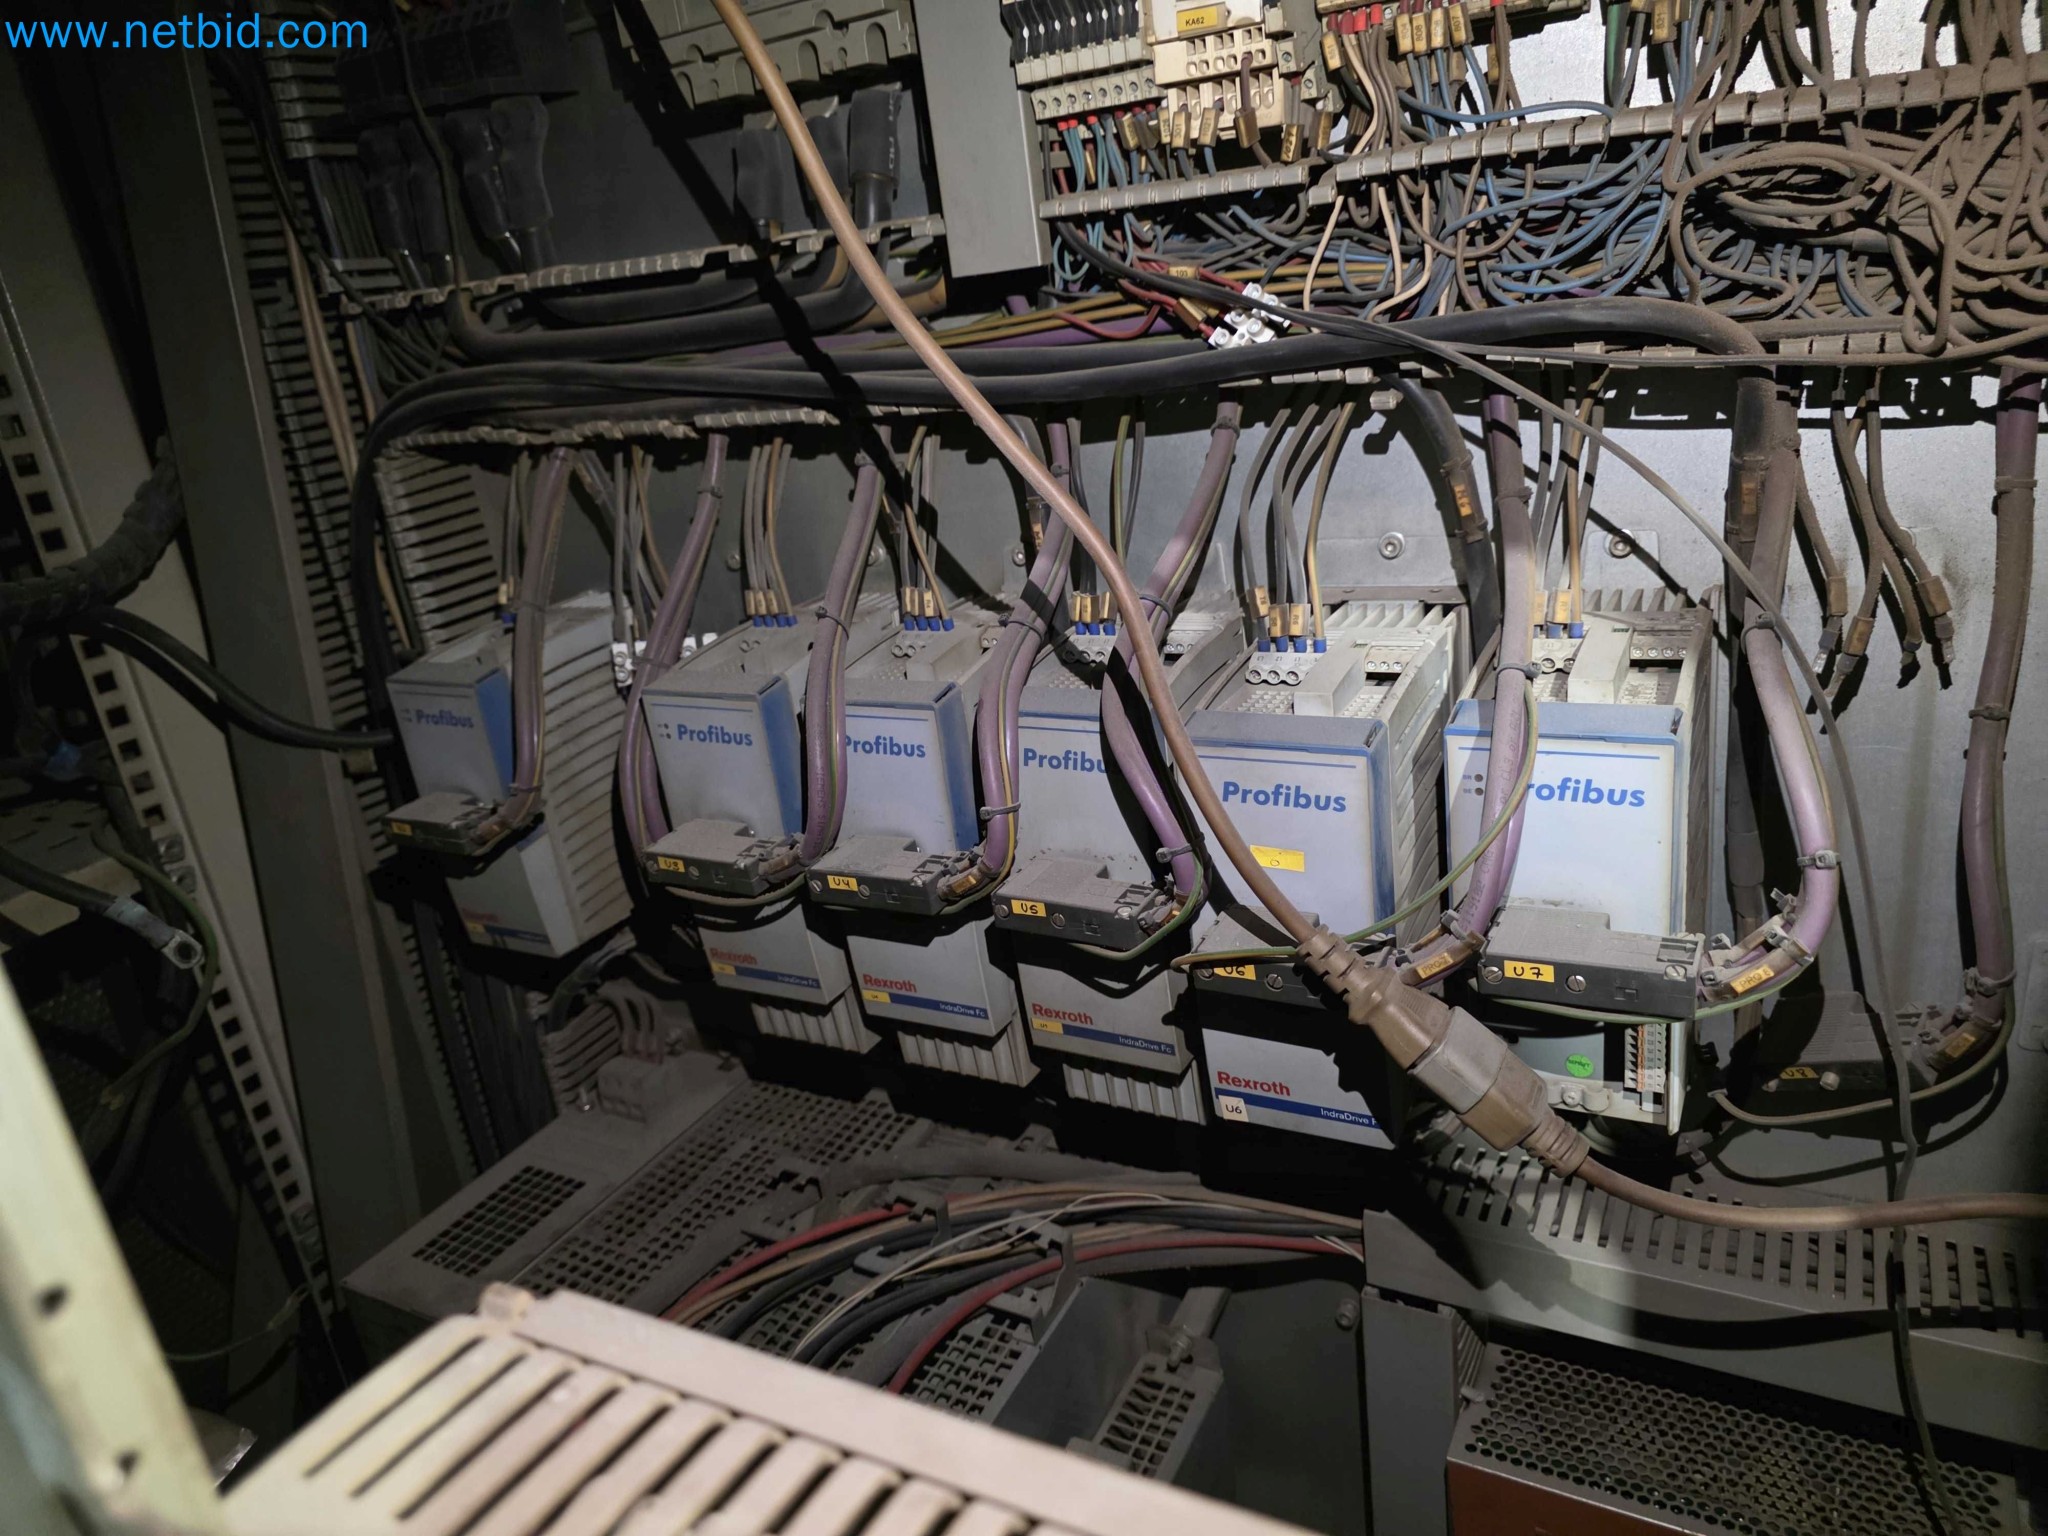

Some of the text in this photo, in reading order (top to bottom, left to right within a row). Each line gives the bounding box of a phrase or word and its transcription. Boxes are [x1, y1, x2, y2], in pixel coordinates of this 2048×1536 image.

[1185, 16, 1205, 27] KA62
[416, 708, 475, 730] Profibus
[677, 722, 753, 748] Profibus
[1023, 747, 1108, 774] Profibu
[1221, 780, 1348, 814] Profibus
[1527, 777, 1646, 808] rofibus
[664, 859, 680, 871] U3
[832, 876, 851, 889] U4
[1020, 902, 1039, 915] U5
[1223, 966, 1246, 977] U6
[862, 973, 918, 993] Rexroth
[939, 1002, 985, 1017] IndraDrive Fc
[1031, 1002, 1094, 1026] Rexroth
[1119, 1036, 1172, 1054] IndraDrive Fc
[1216, 1070, 1292, 1097] Rexroth
[1225, 1104, 1243, 1115] U6
[1320, 1108, 1370, 1125] IndraDrive
